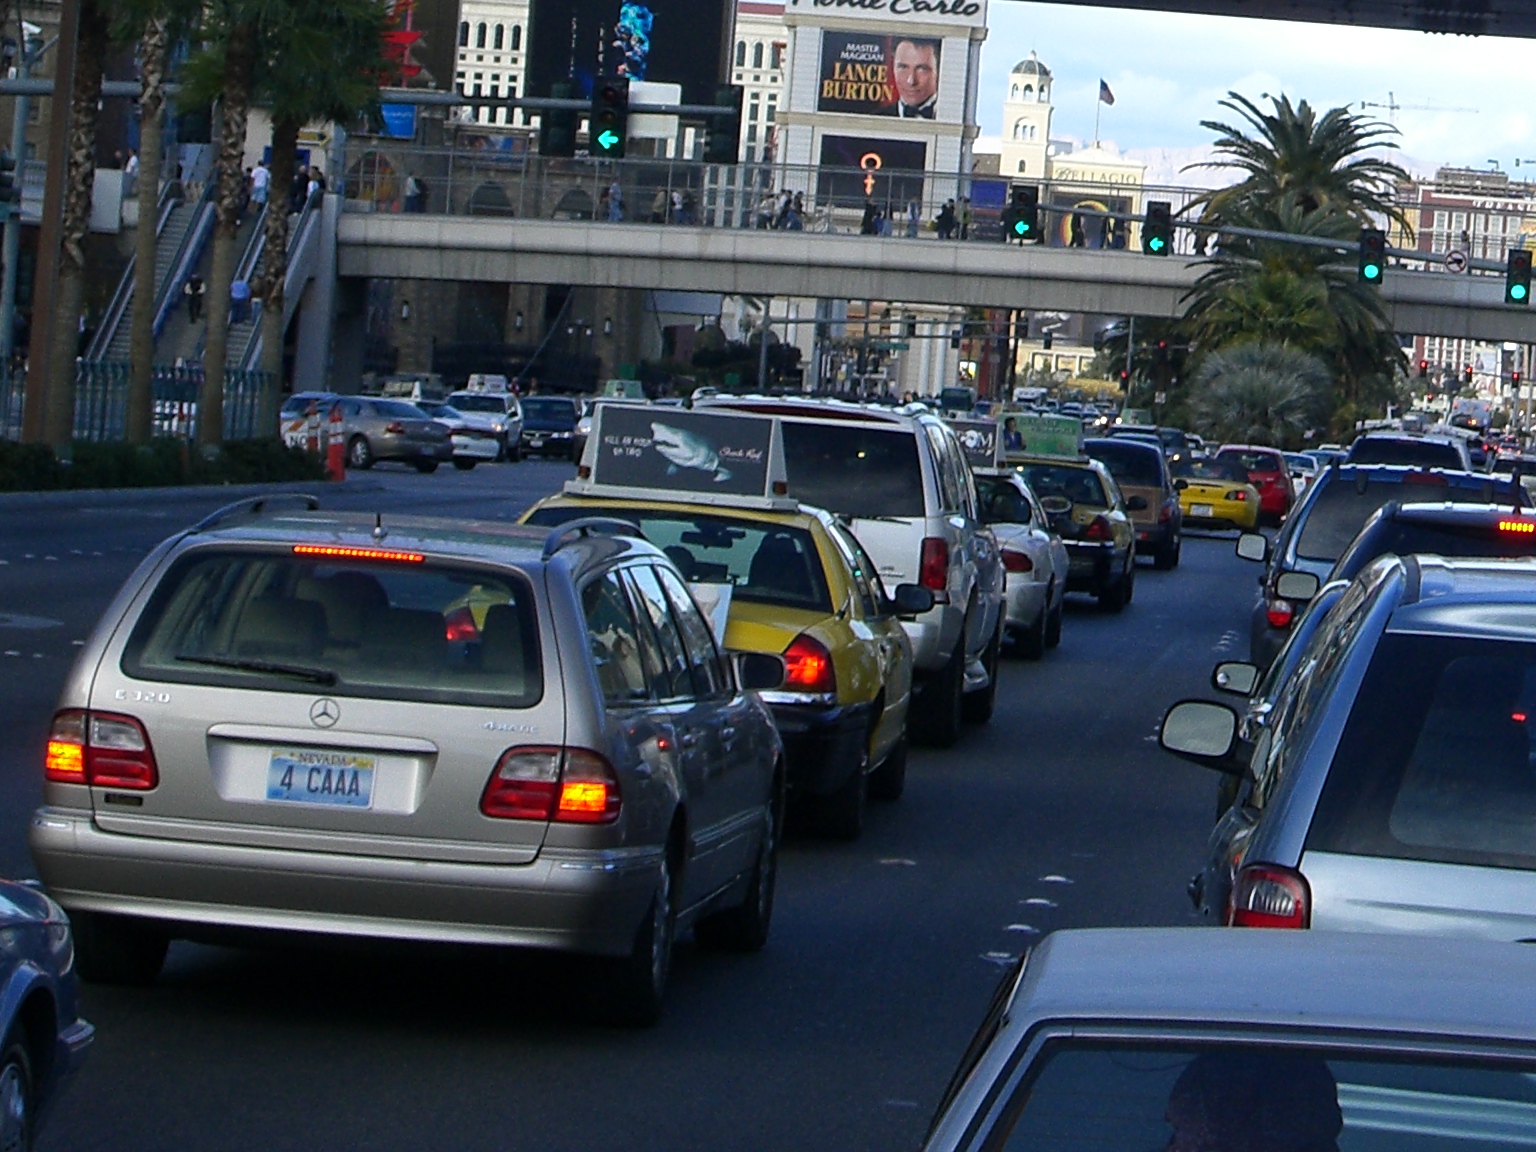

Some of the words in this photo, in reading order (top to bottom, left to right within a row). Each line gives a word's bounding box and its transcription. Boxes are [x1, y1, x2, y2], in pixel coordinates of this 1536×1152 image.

[841, 51, 885, 62] MAGICIAN
[846, 42, 880, 53] MASTER
[833, 62, 888, 83] LANCE
[822, 79, 893, 102] BURTON
[1056, 167, 1137, 185] BELLAGIO
[299, 753, 347, 766] NEVADA
[280, 765, 294, 791] 4
[307, 766, 360, 797] CAAA
